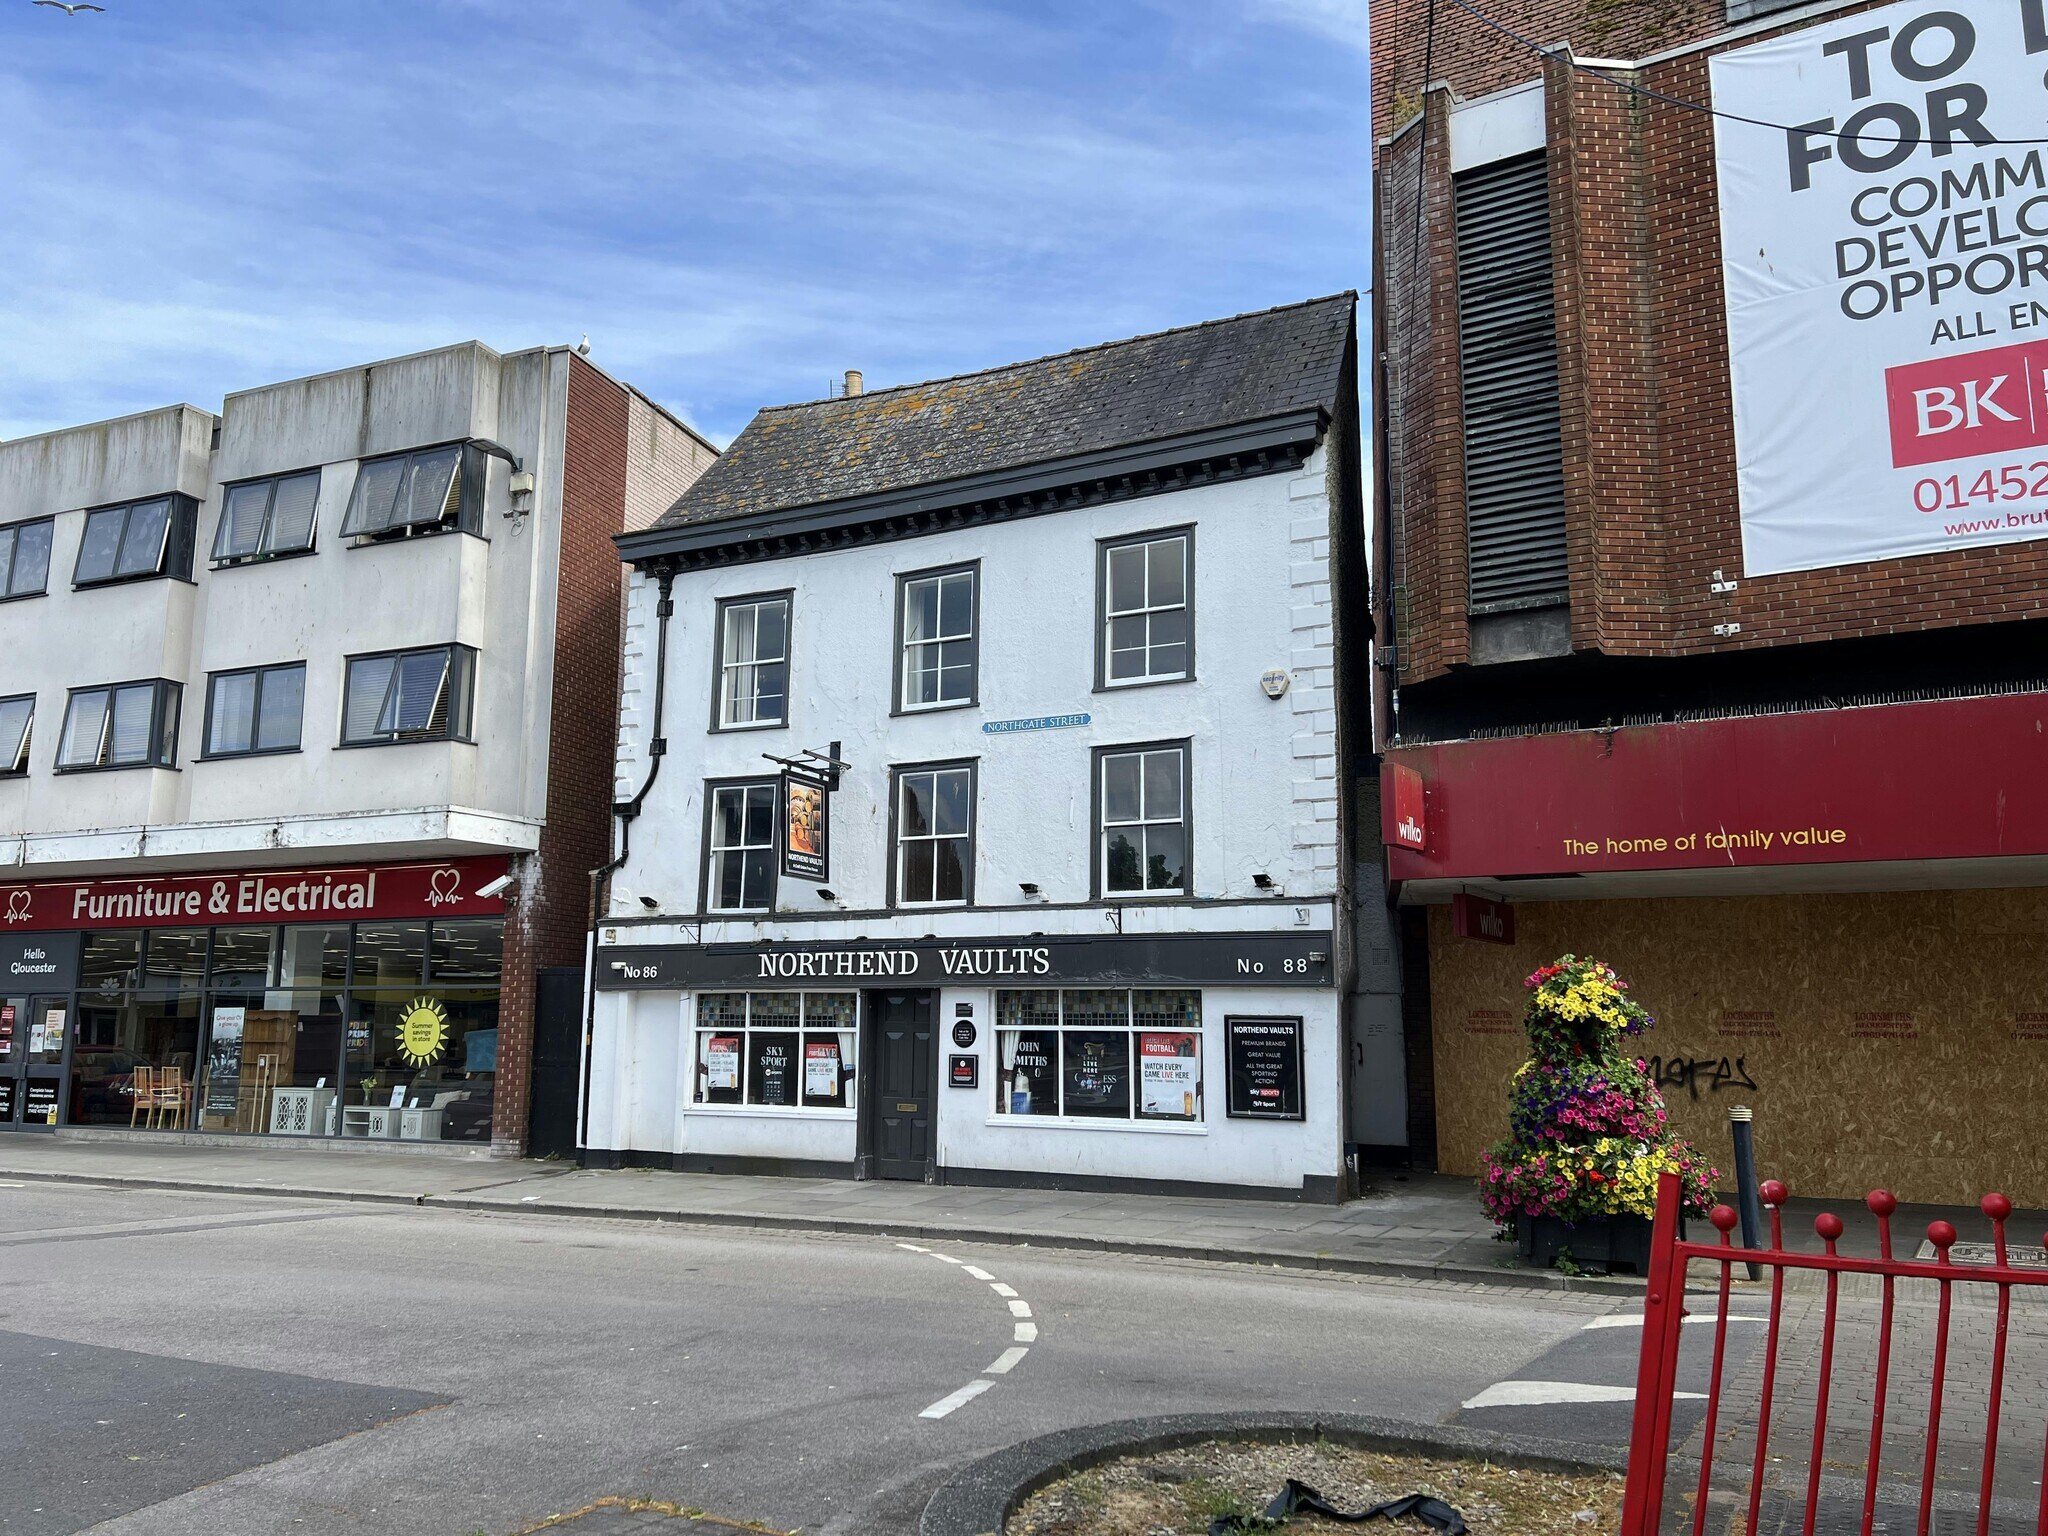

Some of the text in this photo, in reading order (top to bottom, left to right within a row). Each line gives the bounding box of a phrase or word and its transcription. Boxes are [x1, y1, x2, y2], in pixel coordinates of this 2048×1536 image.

[1823, 11, 1976, 101] TO
[1786, 82, 1998, 192] FOR
[1851, 149, 2046, 227] COMM
[1840, 244, 2048, 320] OPPOR
[1930, 311, 1996, 345] ALL
[1912, 375, 2022, 437] BK
[1913, 461, 2048, 513] 01452
[987, 715, 1086, 732] NORTHGATE STREET
[1398, 816, 1422, 843] wilko
[1564, 827, 1847, 856] The home of family value
[72, 873, 376, 919] Furniture & Electrical
[1480, 905, 1503, 938] wilko
[24, 948, 46, 960] Hello
[11, 962, 57, 975] Gloucester
[757, 948, 1050, 977] NORTHEND VAULTS
[1237, 958, 1307, 973] No 88
[624, 965, 658, 978] No 86
[1722, 1011, 1775, 1020] LOCKSMITHS
[1854, 1012, 1912, 1021] LOCKSMITHS
[348, 1030, 369, 1038] PRIDE
[1234, 1026, 1268, 1034] NORTHEND
[347, 1038, 369, 1047] PRIDE
[1019, 1042, 1040, 1052] OHN
[1145, 1044, 1175, 1052] FOOTBALL
[766, 1046, 784, 1056] SKY
[760, 1056, 788, 1067] SPORT
[1249, 1088, 1259, 1096] sky
